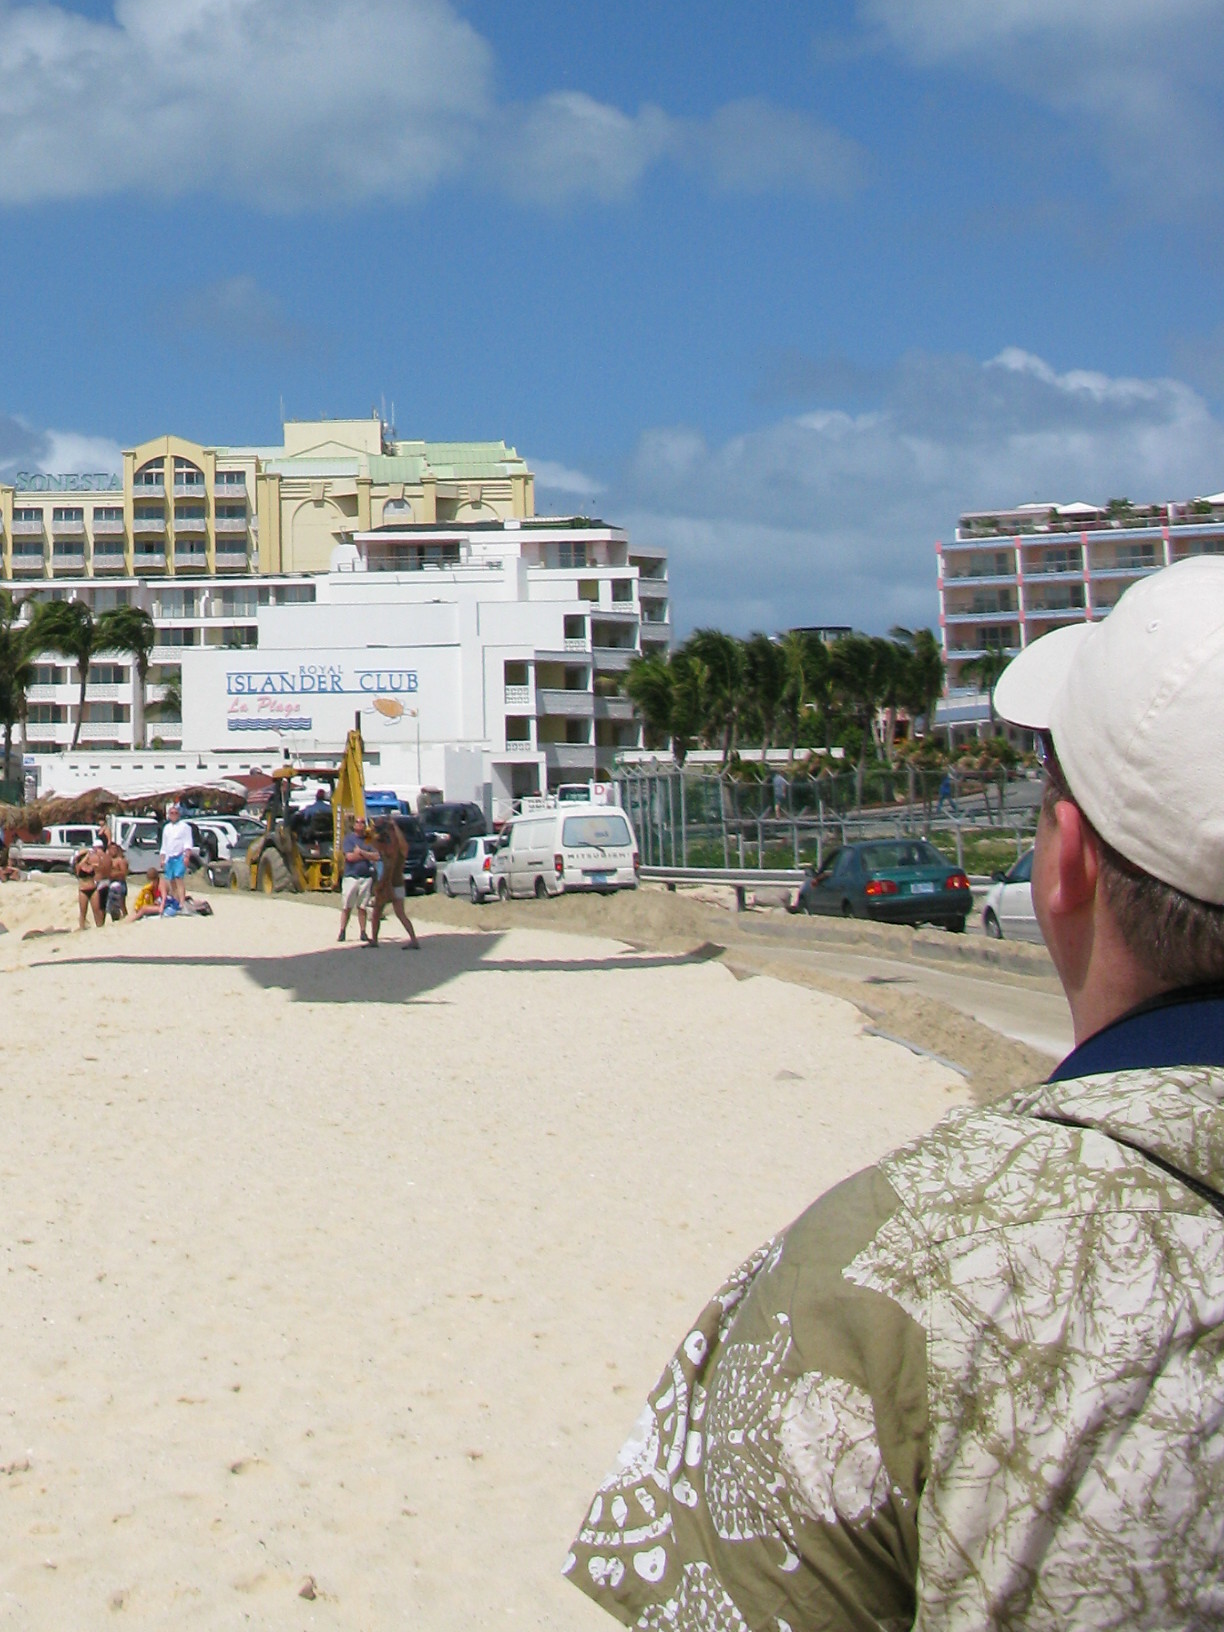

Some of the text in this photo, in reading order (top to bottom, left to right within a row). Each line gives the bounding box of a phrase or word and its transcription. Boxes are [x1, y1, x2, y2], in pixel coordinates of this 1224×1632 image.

[16, 471, 123, 491] SONESTA
[299, 665, 345, 674] ROYAL
[227, 673, 419, 691] ISLANDER CLUB
[227, 696, 301, 717] La Plage
